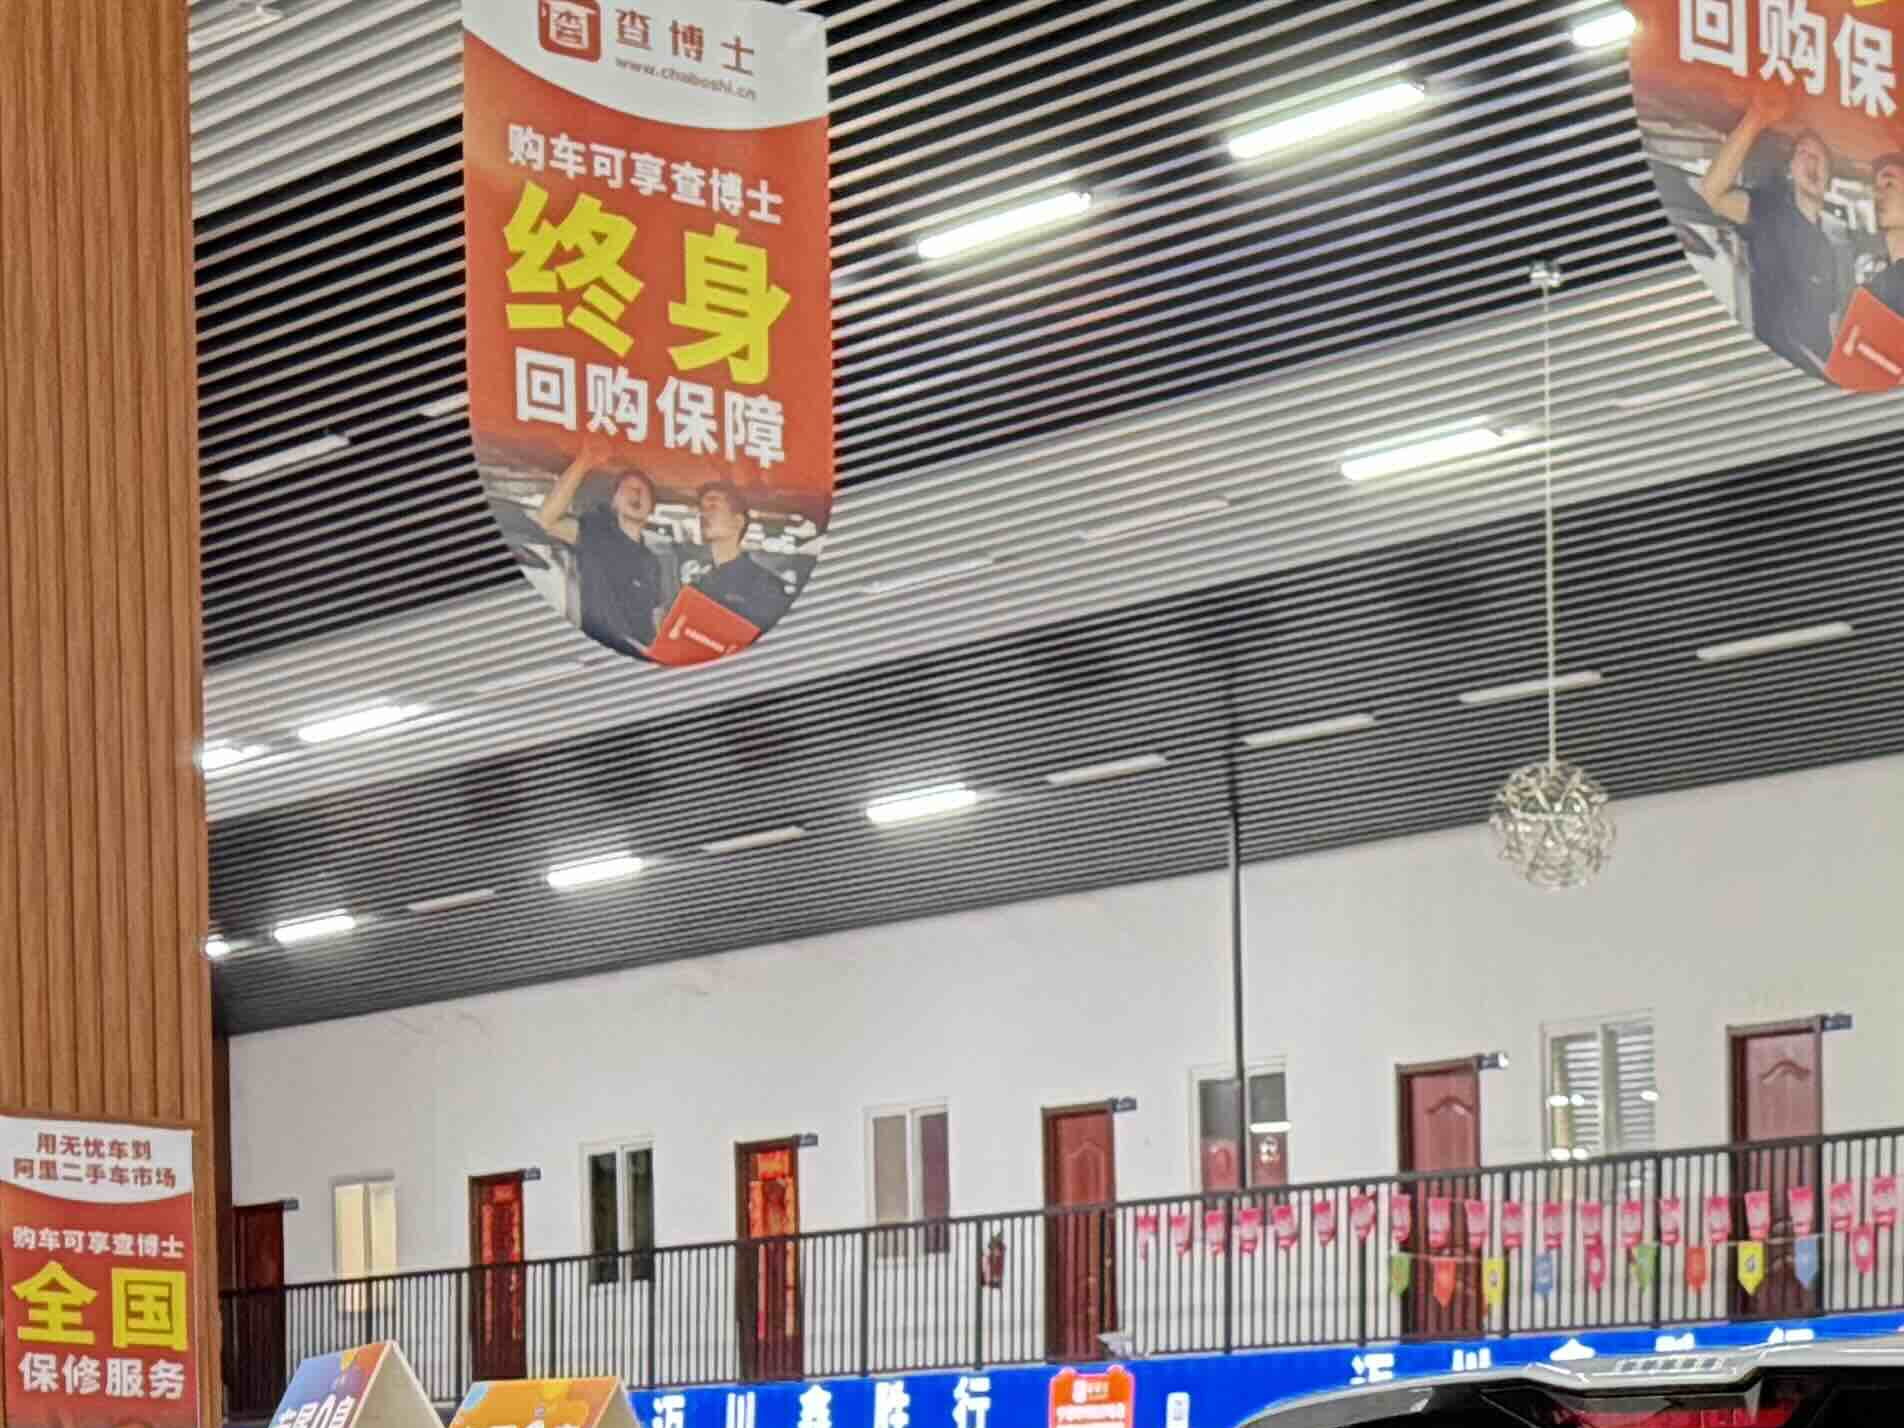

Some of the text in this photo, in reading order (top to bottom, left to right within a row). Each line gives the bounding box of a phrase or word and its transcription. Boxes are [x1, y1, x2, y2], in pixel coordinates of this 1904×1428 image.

[615, 8, 756, 77] 查博士
[508, 124, 782, 225] 购车可享查博士
[503, 180, 791, 386] 终身
[514, 346, 785, 469] 回购保障
[13, 1157, 176, 1189] 阿里二手车市场
[36, 1132, 152, 1160] 用无忧车到
[12, 1226, 184, 1259] 购车可享查博士
[12, 1261, 188, 1352] 全国
[18, 1351, 186, 1399] 保修服务
